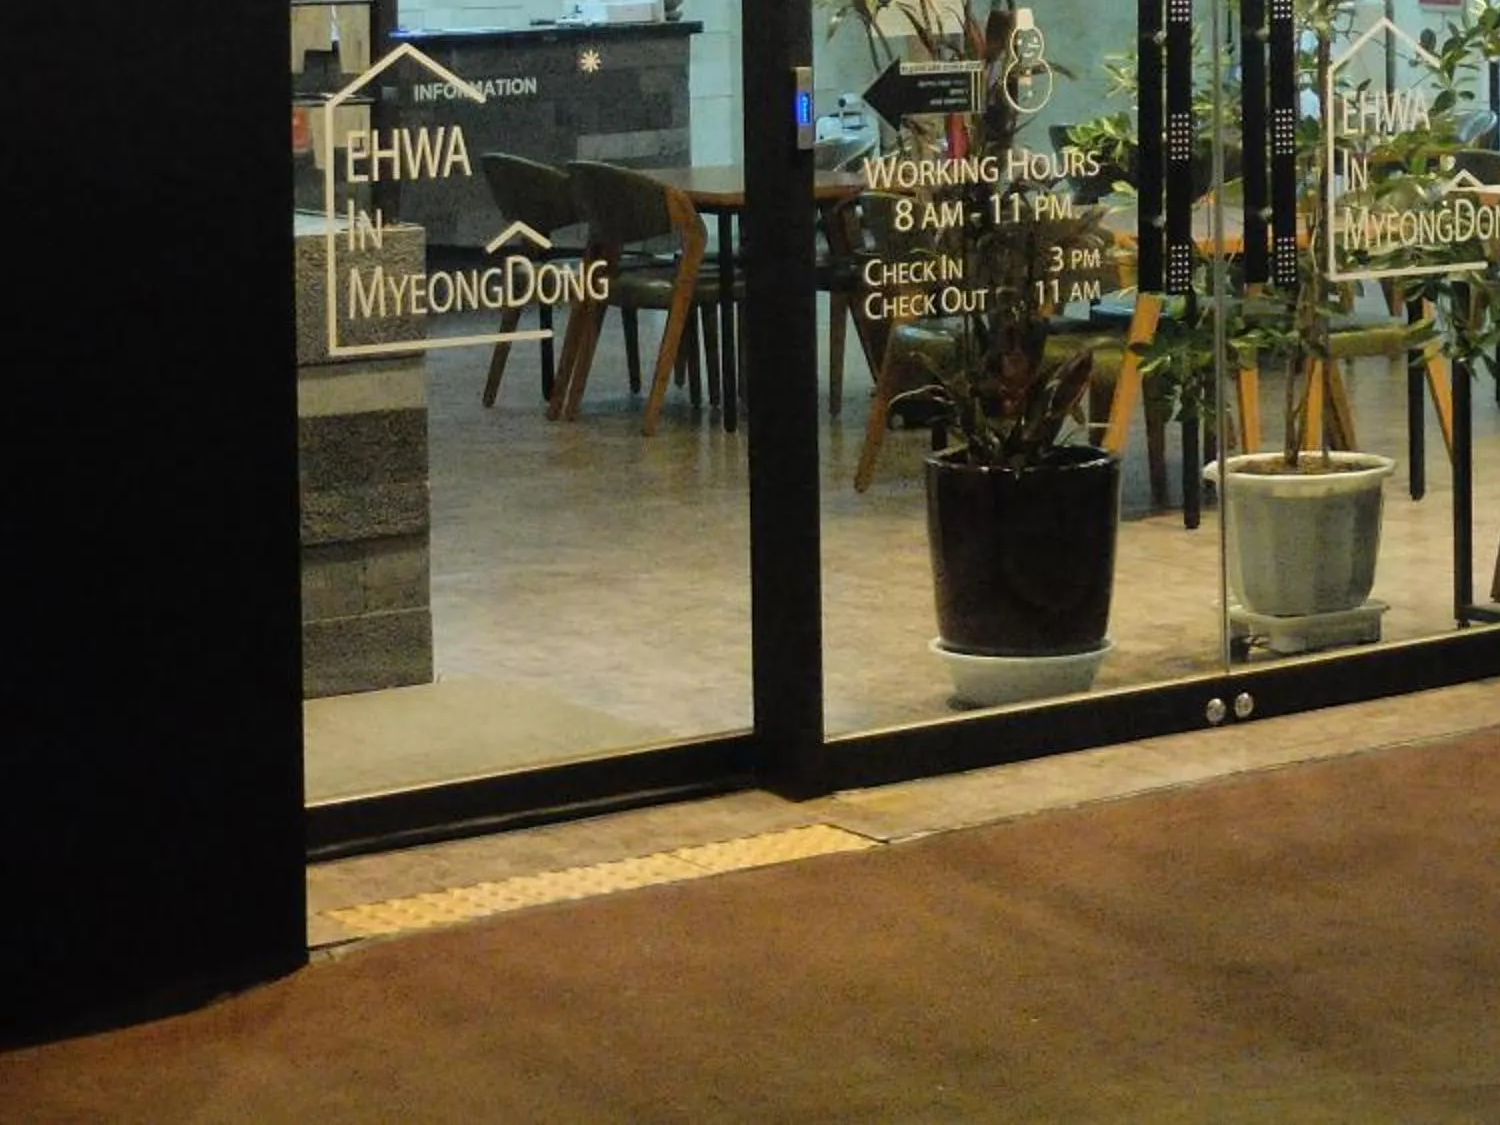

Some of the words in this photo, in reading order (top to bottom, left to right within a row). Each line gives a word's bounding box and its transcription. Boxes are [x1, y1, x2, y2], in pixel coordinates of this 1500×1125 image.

[1342, 88, 1431, 135] EHWA
[347, 125, 473, 183] EHWA
[863, 155, 999, 190] WORKING
[1006, 148, 1101, 181] HOURS
[1342, 148, 1368, 192] IN
[347, 199, 383, 252] IN
[894, 198, 914, 231] 8
[921, 201, 965, 230] AM
[989, 192, 1021, 224] 11
[1034, 194, 1074, 221] PM
[348, 255, 610, 320] MYEONGDONG
[864, 258, 937, 286] CHECK
[940, 254, 963, 280] IN
[1049, 246, 1065, 272] 3
[1070, 248, 1101, 270] PM
[864, 292, 937, 320] CHECK
[941, 286, 989, 313] OUT
[1035, 279, 1060, 305] 11
[1069, 280, 1101, 302] AM
